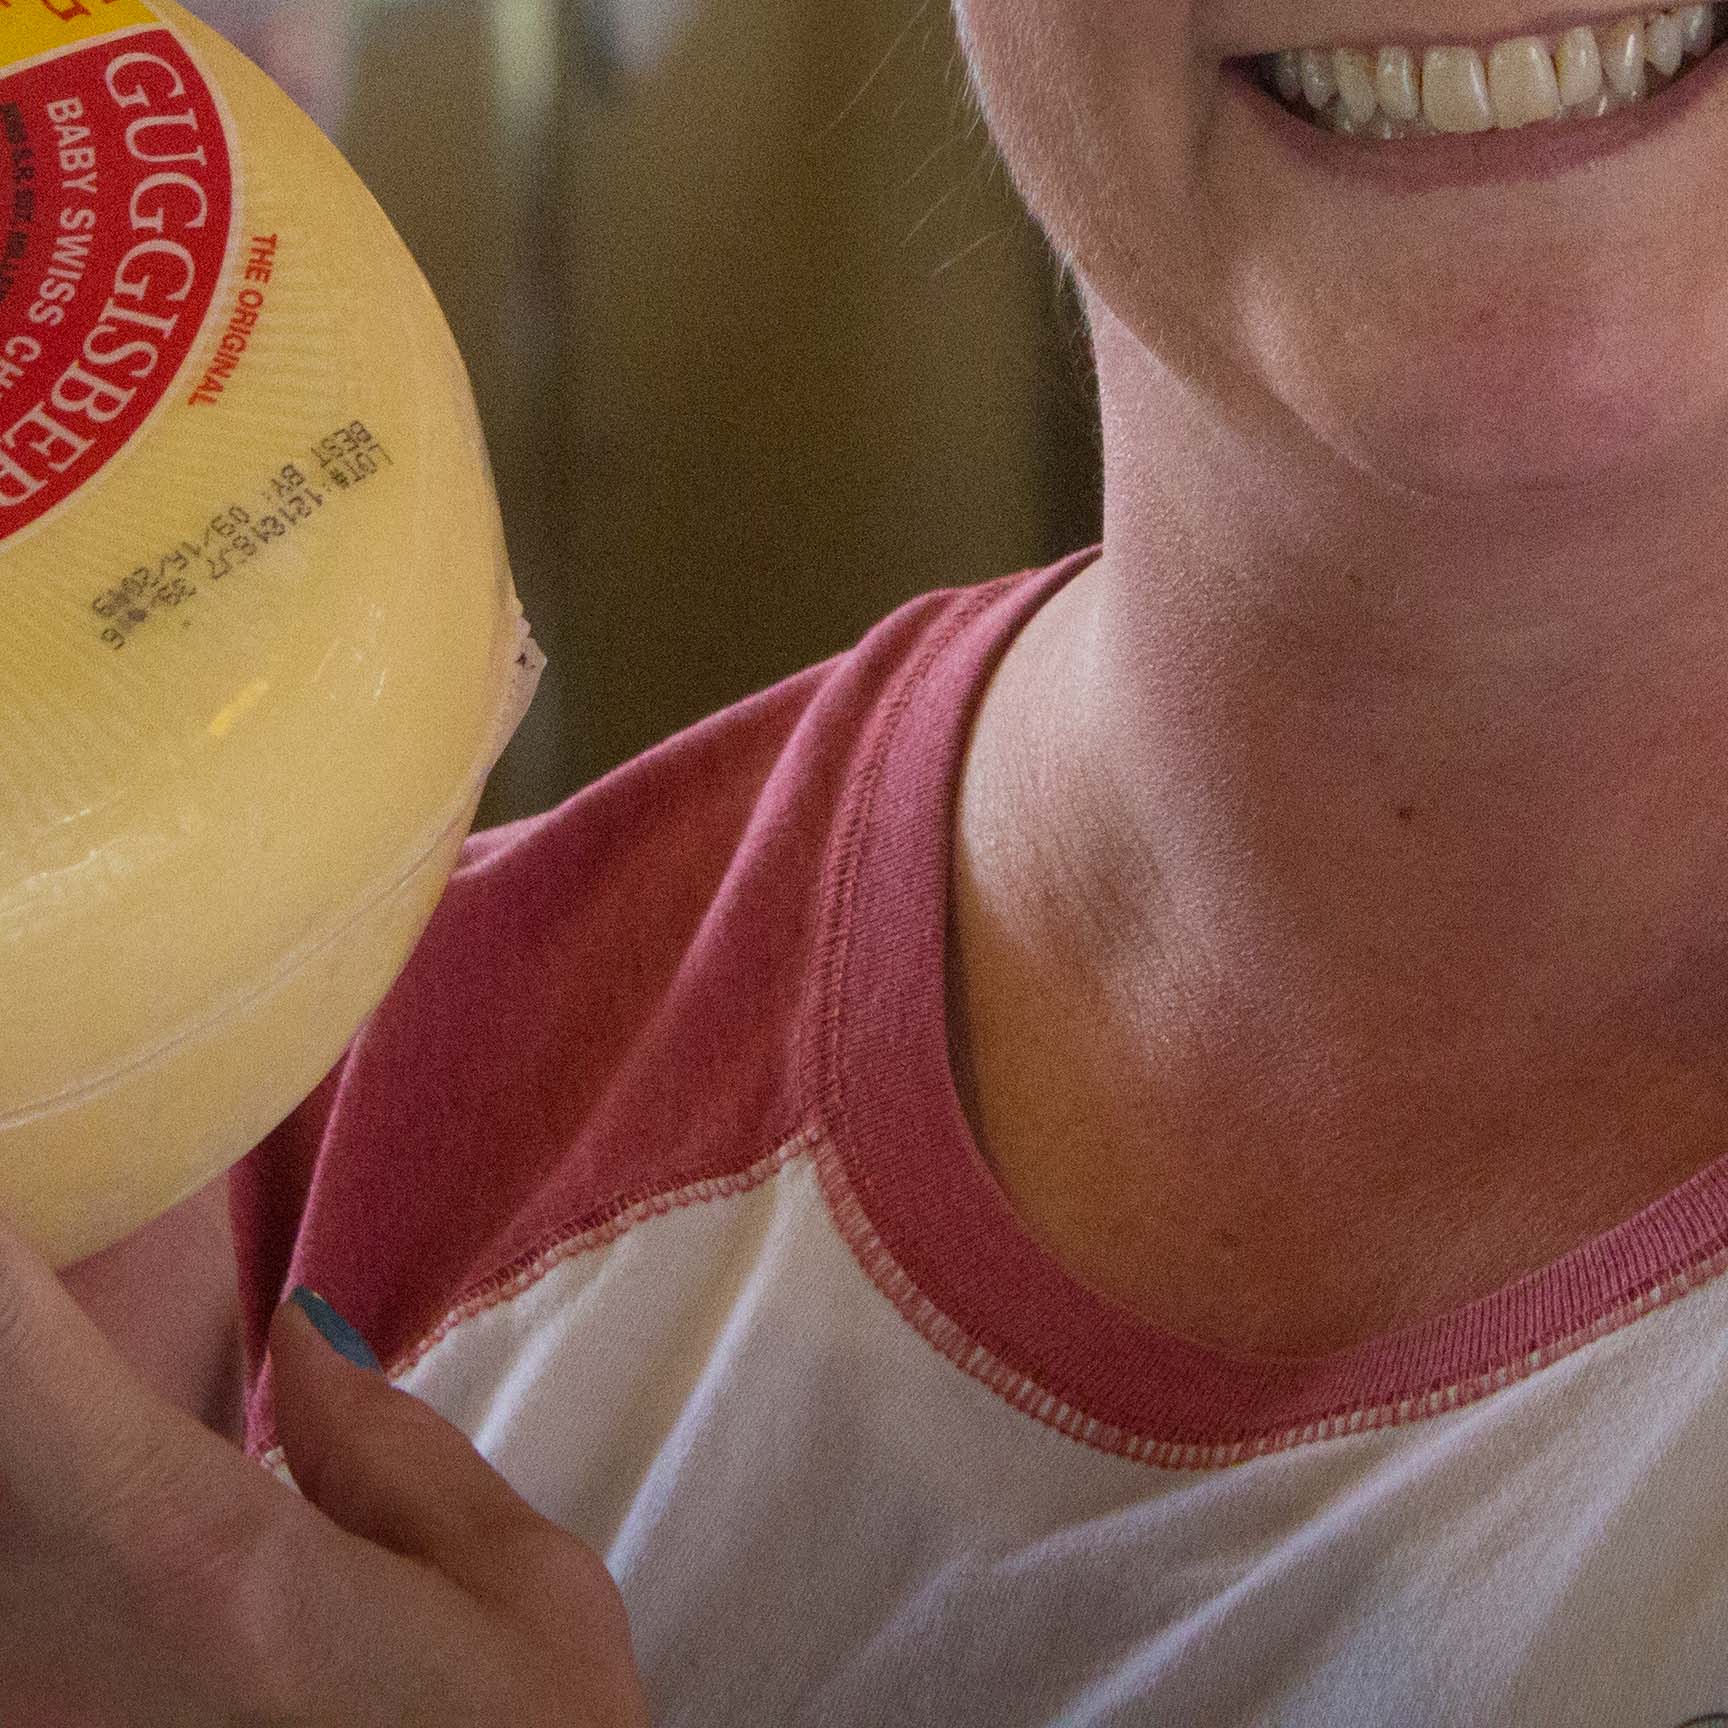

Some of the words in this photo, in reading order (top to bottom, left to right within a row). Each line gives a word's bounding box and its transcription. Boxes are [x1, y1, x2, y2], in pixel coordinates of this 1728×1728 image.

[47, 97, 97, 193] BABY
[28, 207, 96, 327] SWISS
[240, 233, 278, 285] THE
[188, 289, 264, 406] ORIGINAL
